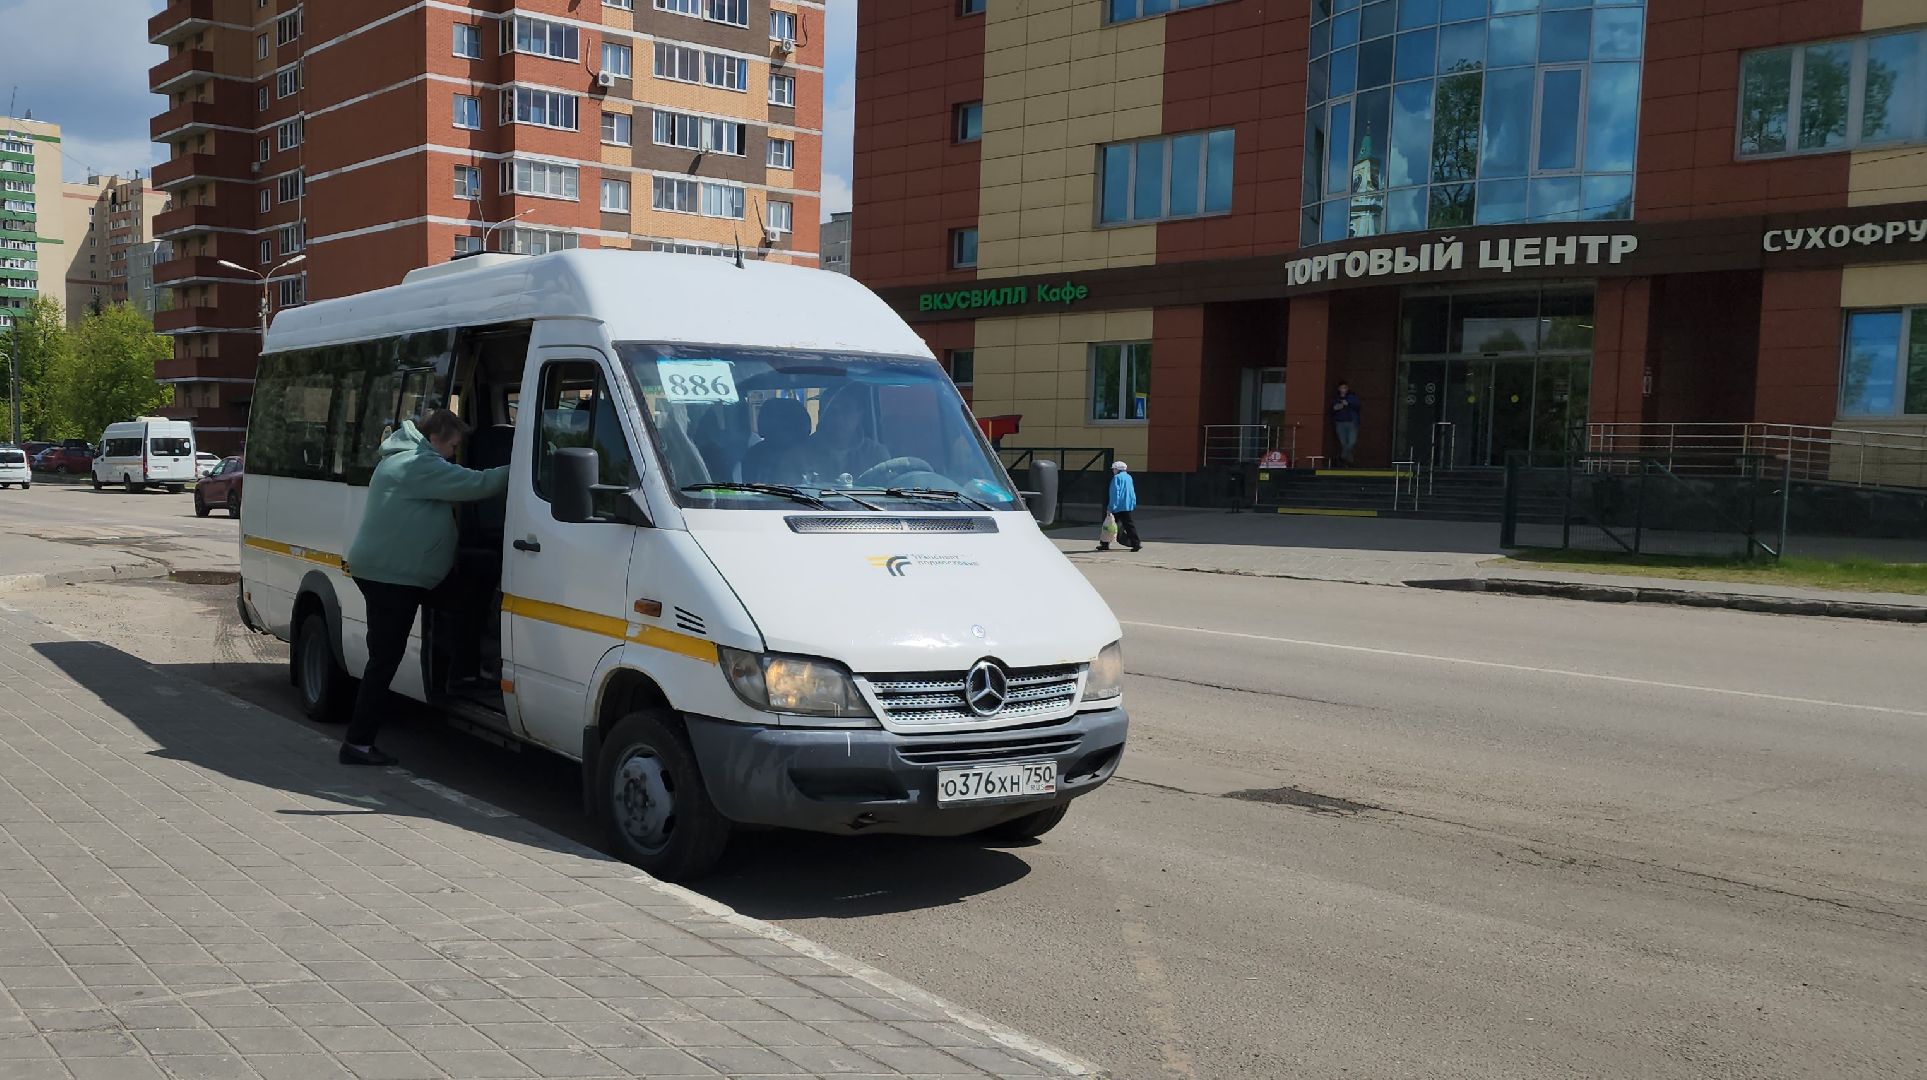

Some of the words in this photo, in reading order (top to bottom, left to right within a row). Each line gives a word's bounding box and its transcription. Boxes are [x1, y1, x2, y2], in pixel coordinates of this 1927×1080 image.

[1763, 219, 1927, 252] СУХОФРУ
[1284, 236, 1463, 286] ТОРГОВЫЙ
[1478, 234, 1638, 273] ЦЕНТР
[919, 286, 1028, 312] ВКУСВИЛЛ
[1037, 281, 1089, 304] Кафе
[668, 373, 730, 396] 886
[1024, 765, 1052, 785] 750
